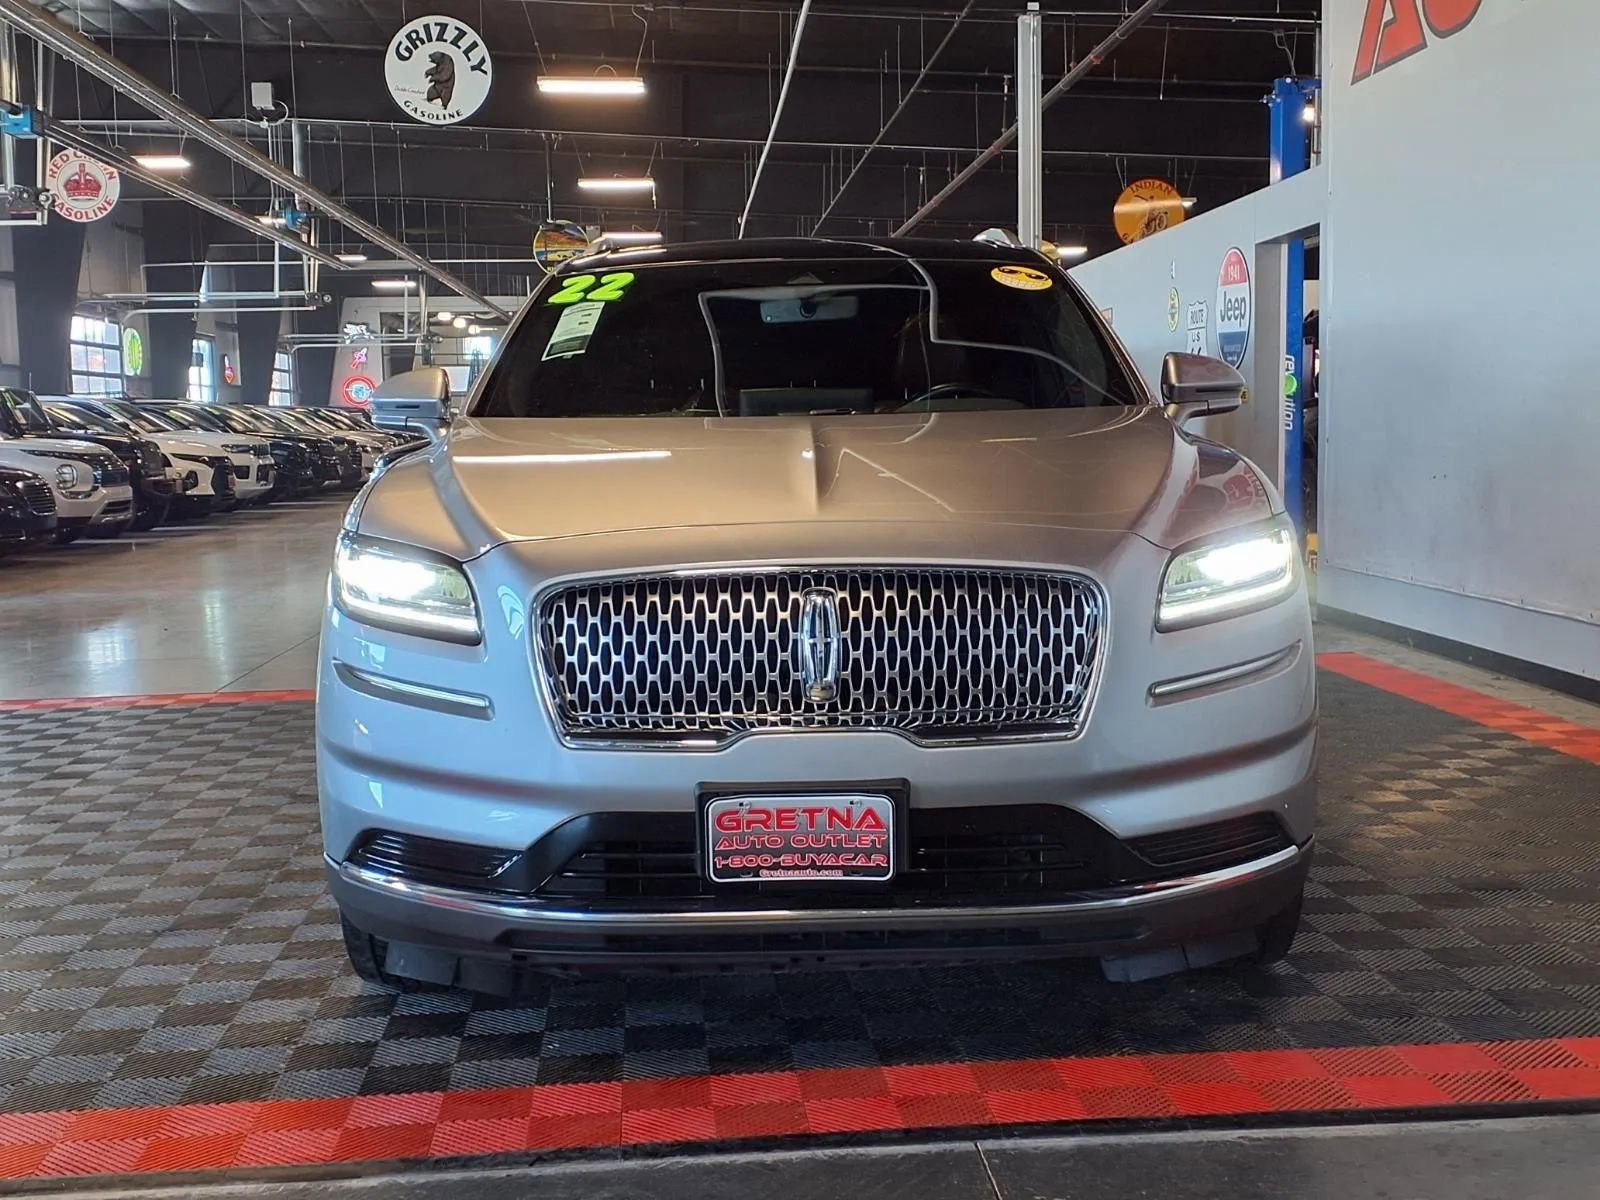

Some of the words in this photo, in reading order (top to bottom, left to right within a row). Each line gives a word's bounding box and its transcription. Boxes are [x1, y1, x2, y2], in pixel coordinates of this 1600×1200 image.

[395, 22, 488, 76] GRIZZLY
[403, 100, 463, 120] GASOLINE
[49, 153, 70, 179] RED
[1130, 181, 1174, 196] INDIAN
[1228, 264, 1240, 281] 1941
[548, 272, 635, 304] 22
[1190, 308, 1204, 325] ROUTE
[1220, 291, 1247, 328] Jeep
[714, 806, 888, 833] GRETNA
[714, 834, 785, 851] AUTO
[790, 833, 889, 849] OUTLET
[714, 853, 889, 869] 1-800-BUYACAR
